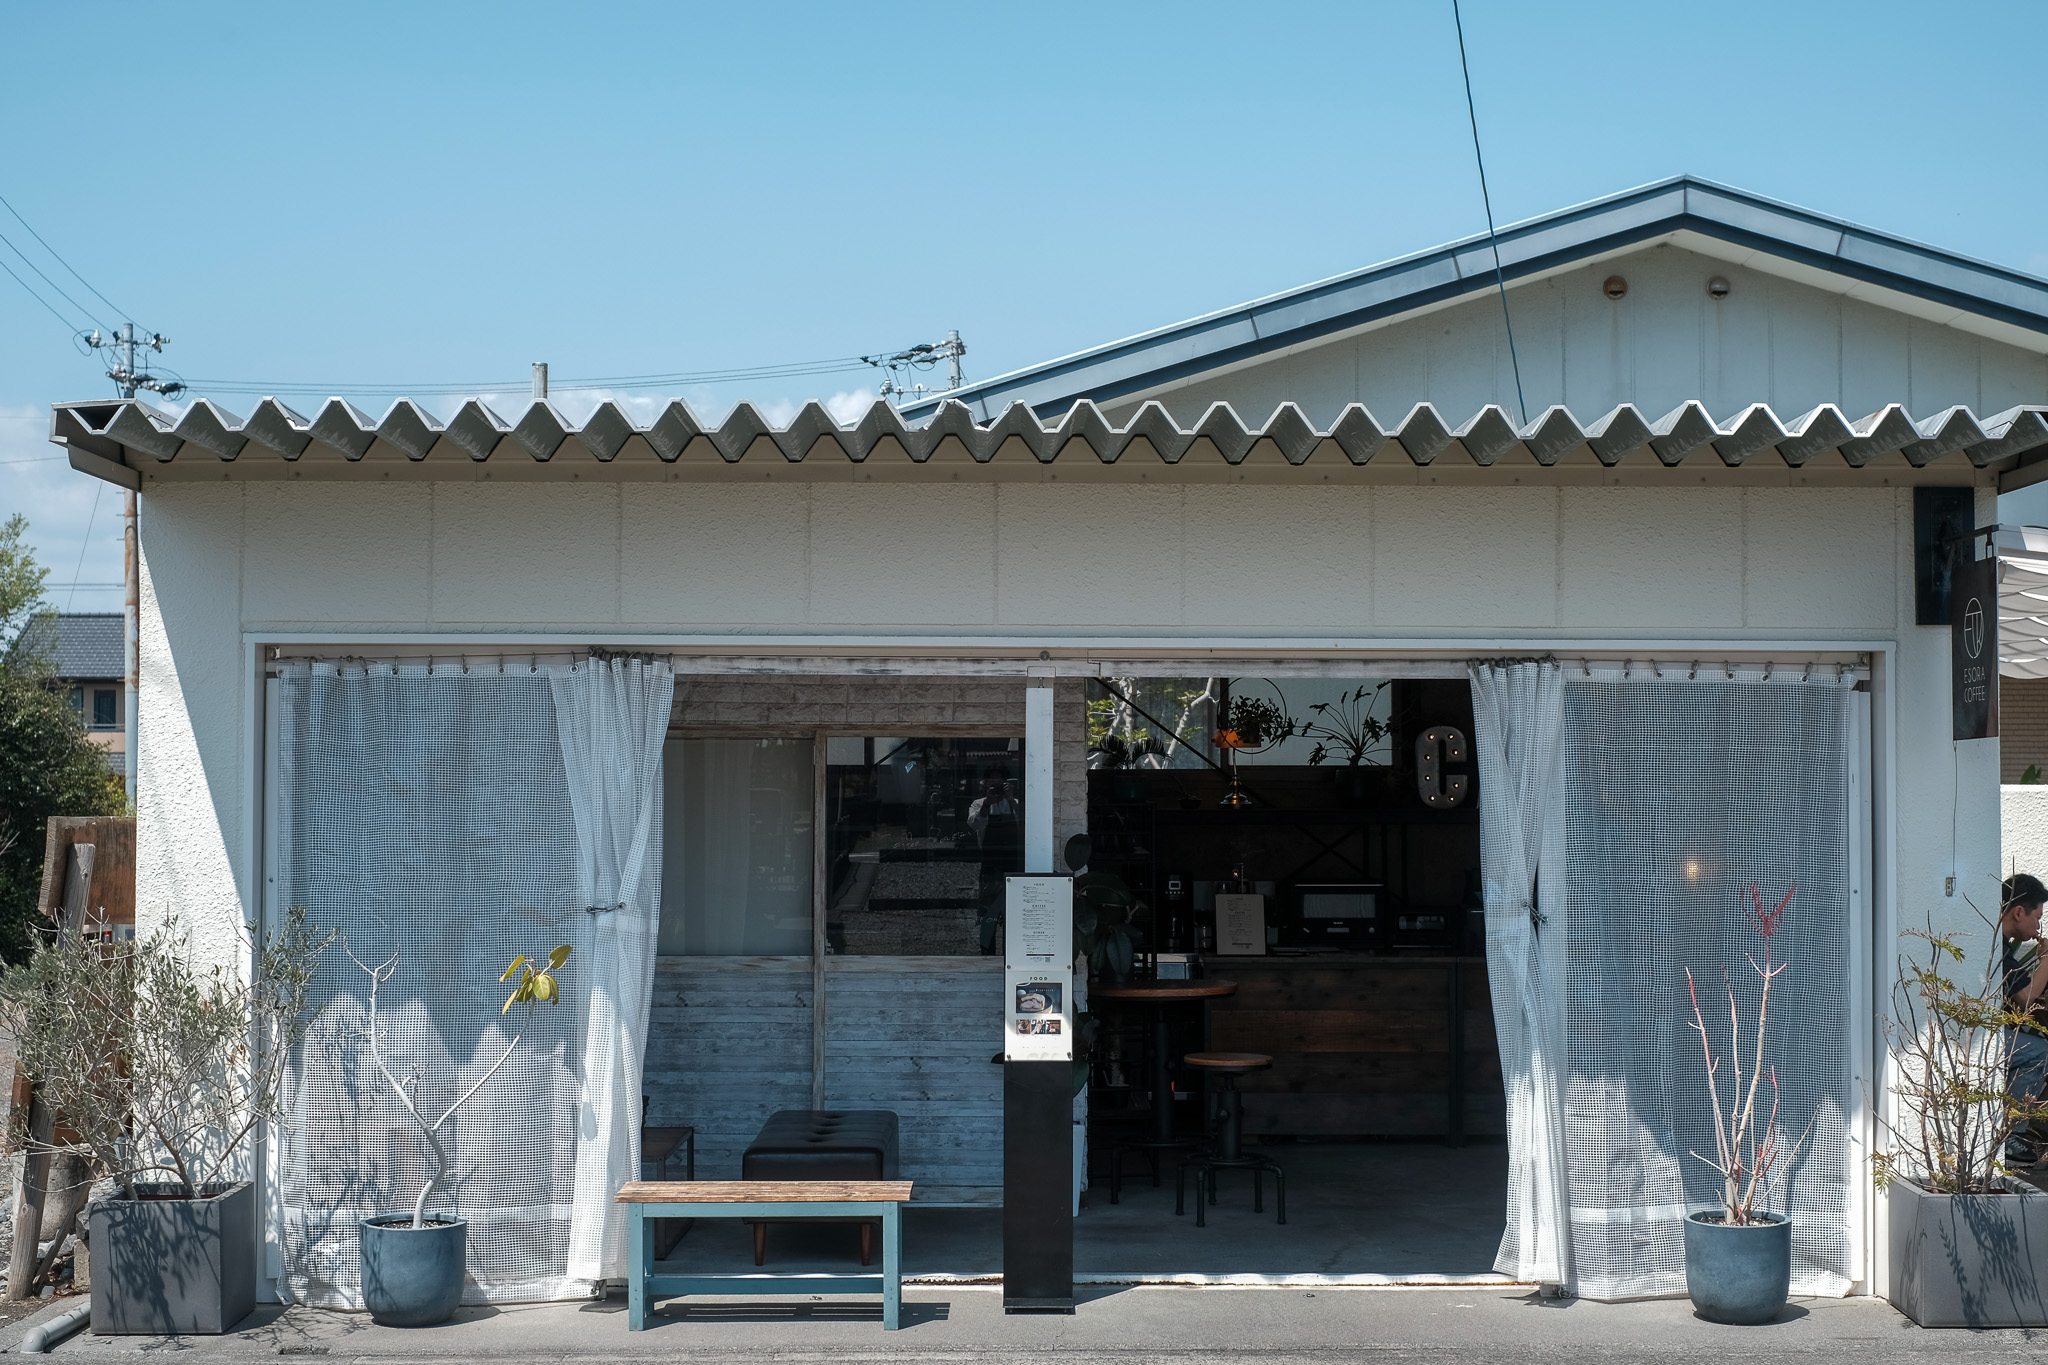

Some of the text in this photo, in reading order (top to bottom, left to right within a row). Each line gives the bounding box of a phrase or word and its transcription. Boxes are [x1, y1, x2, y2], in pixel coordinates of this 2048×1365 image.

[1964, 667, 1985, 684] ESORA
[1964, 686, 1985, 703] COFFEE
[1415, 726, 1468, 808] C
